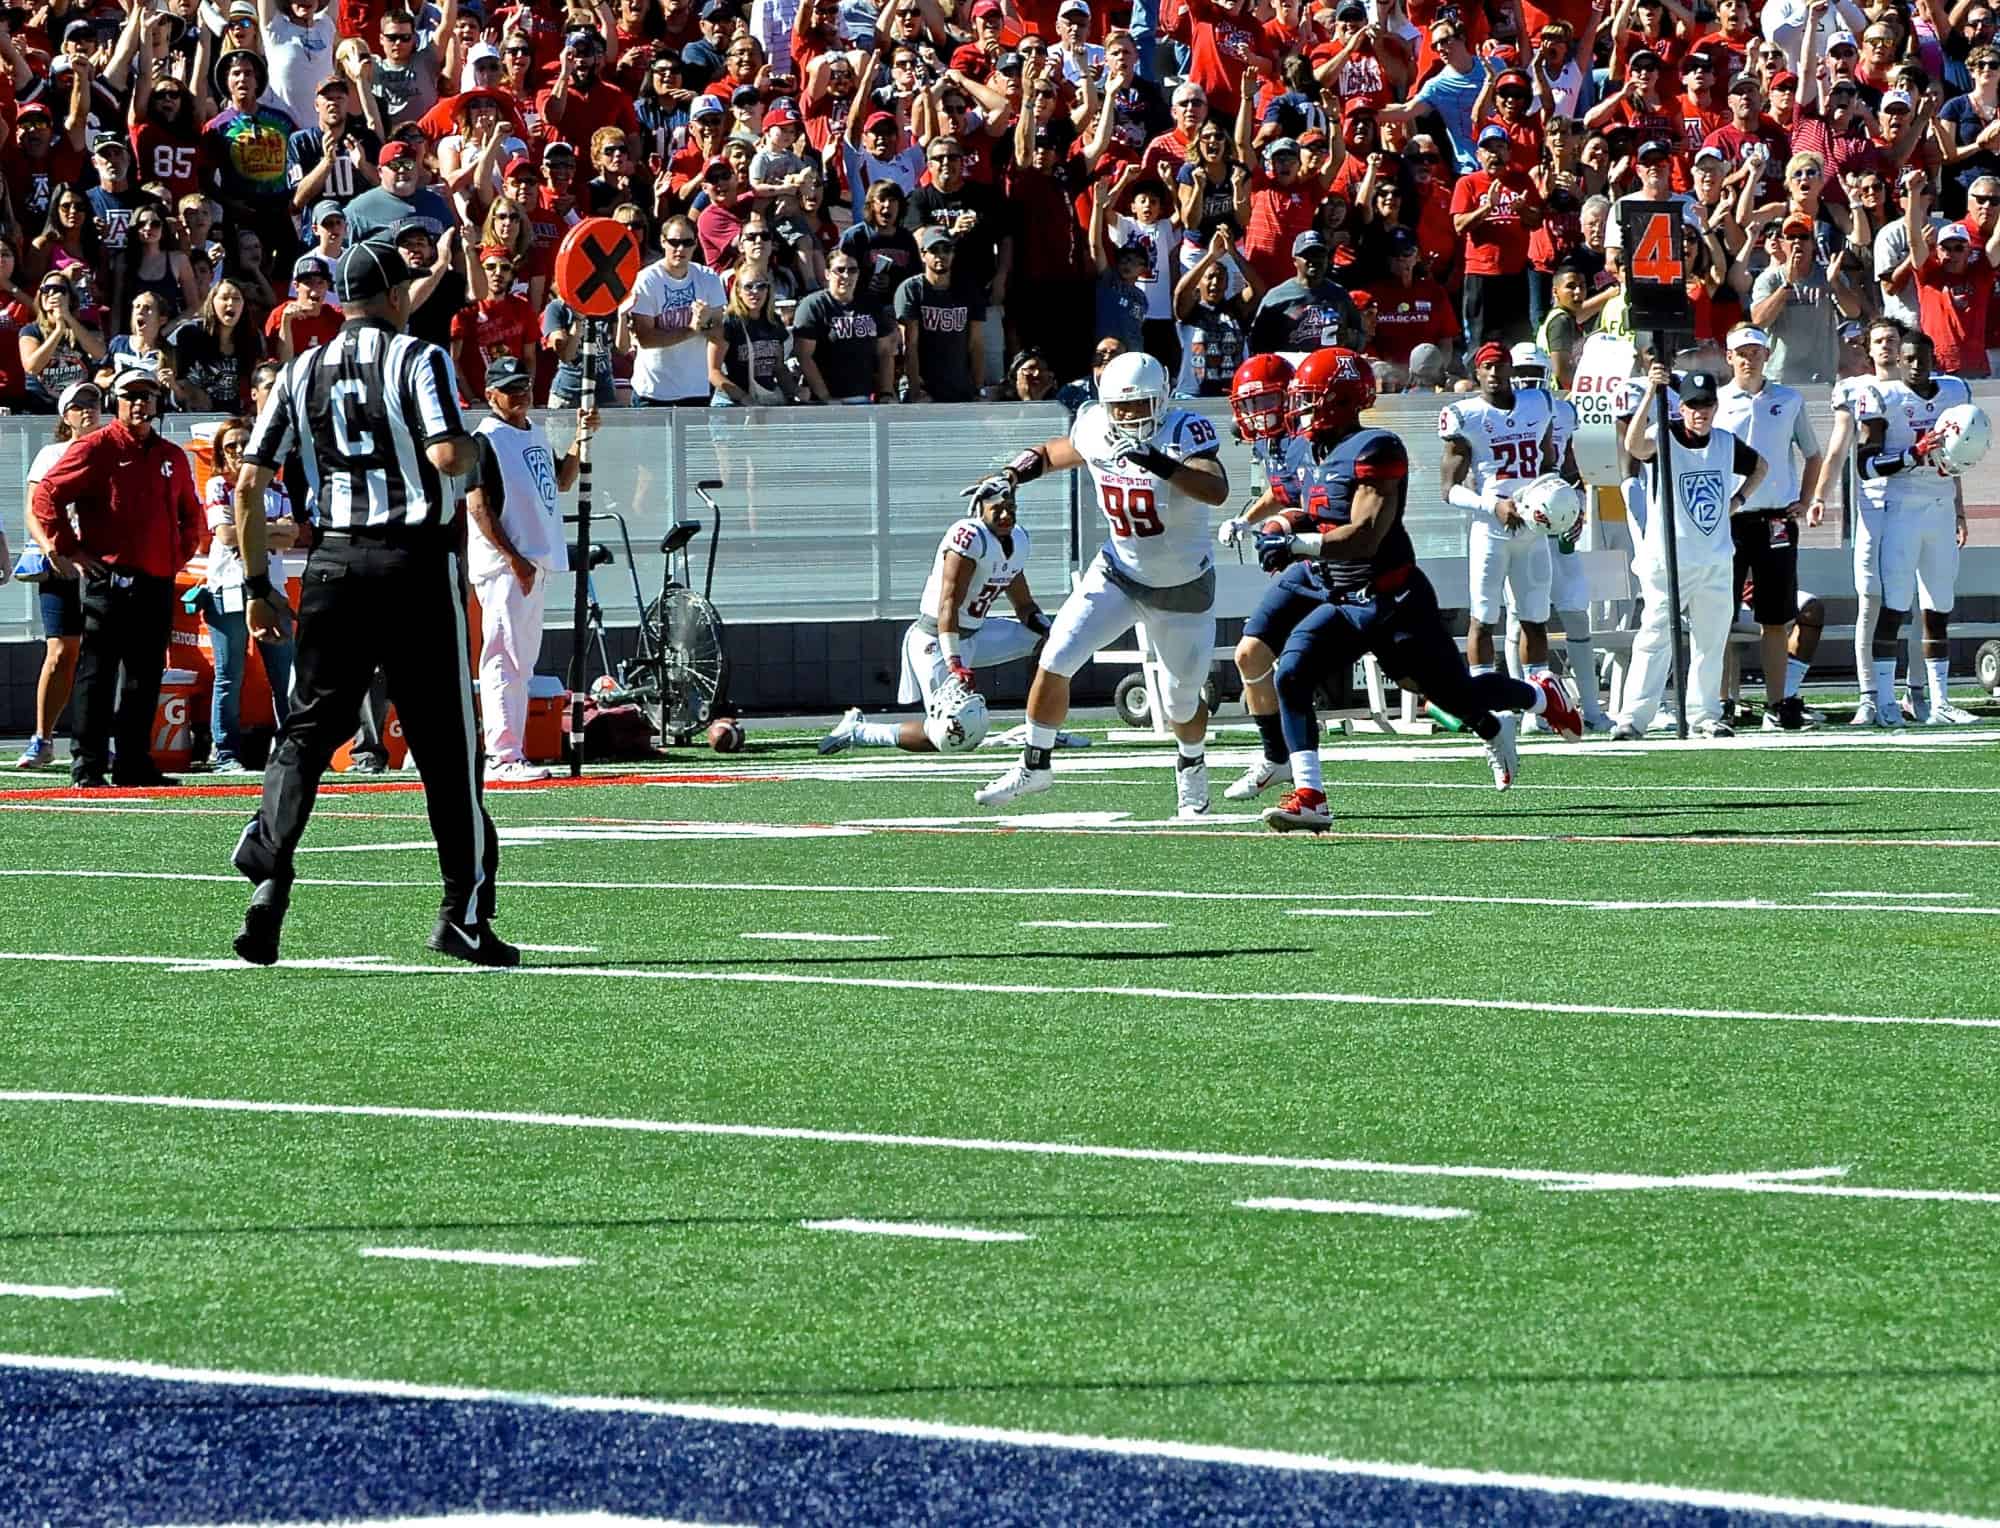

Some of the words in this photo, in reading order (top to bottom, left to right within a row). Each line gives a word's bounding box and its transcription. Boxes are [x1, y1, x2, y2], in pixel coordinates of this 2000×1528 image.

[154, 145, 196, 178] 85
[322, 156, 354, 196] 10
[1480, 190, 1519, 206] BAR
[104, 209, 134, 248] A
[1632, 213, 1682, 284] 4
[575, 233, 633, 304] X
[920, 305, 968, 332] WSU
[1335, 355, 1361, 380] A
[1577, 376, 1622, 393] BIG
[1575, 395, 1612, 412] FOG
[1615, 391, 1629, 411] 41
[331, 379, 375, 456] C
[1187, 418, 1218, 446] 99
[1490, 440, 1538, 480] 28
[1101, 484, 1165, 538] 99
[1699, 504, 1716, 521] 12
[953, 527, 977, 551] 35
[165, 698, 186, 724] G
[389, 720, 403, 737] G
